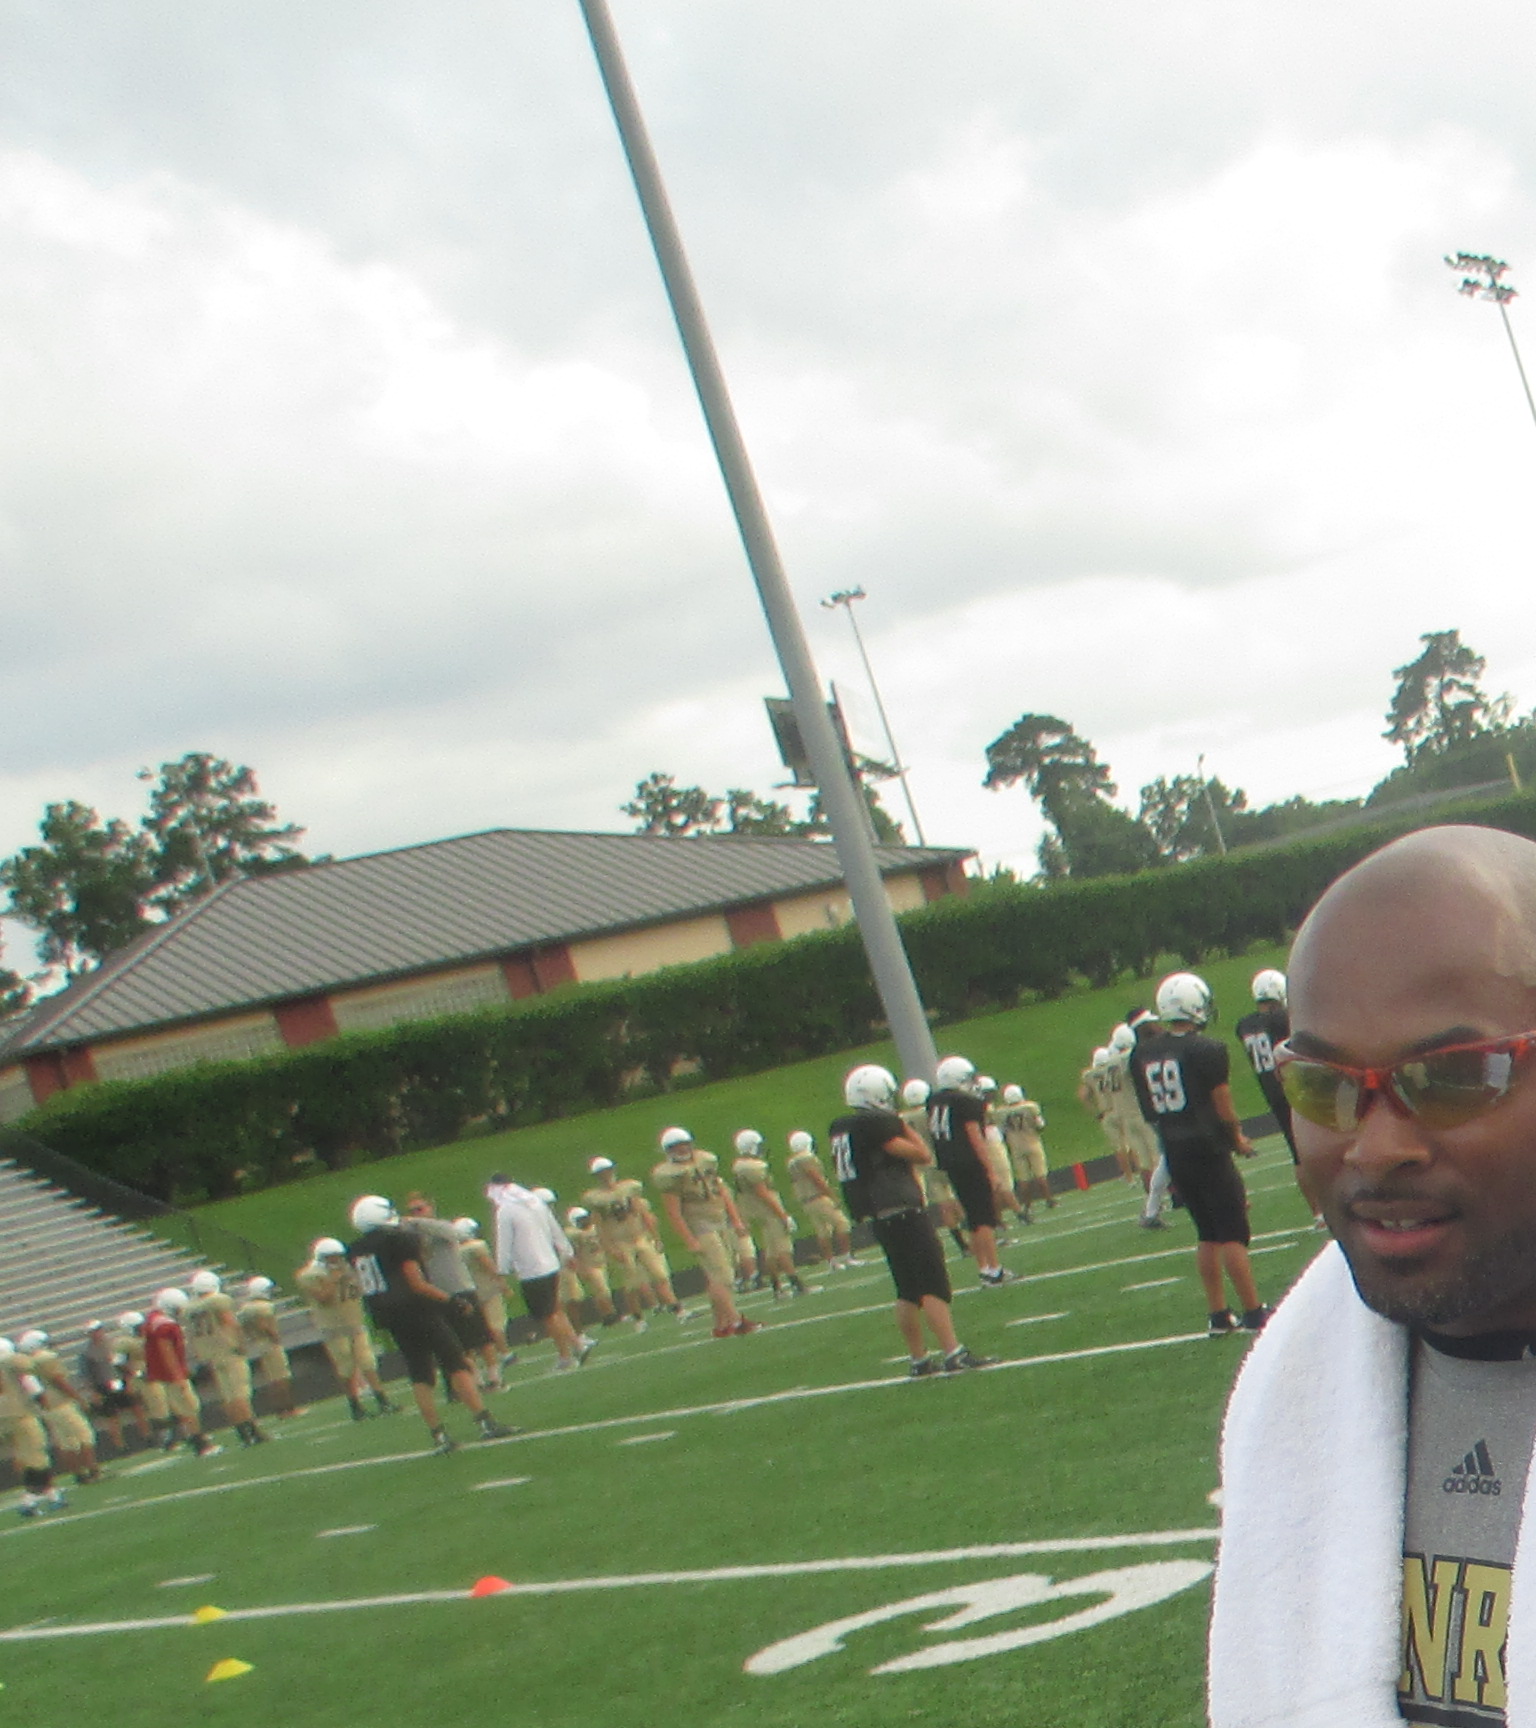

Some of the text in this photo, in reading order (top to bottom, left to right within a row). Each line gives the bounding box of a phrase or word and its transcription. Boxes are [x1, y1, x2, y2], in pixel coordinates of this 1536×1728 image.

[1243, 1032, 1276, 1074] 79
[1146, 1060, 1187, 1113] 59
[929, 1104, 951, 1140] 44
[1442, 1474, 1502, 1496] adidas
